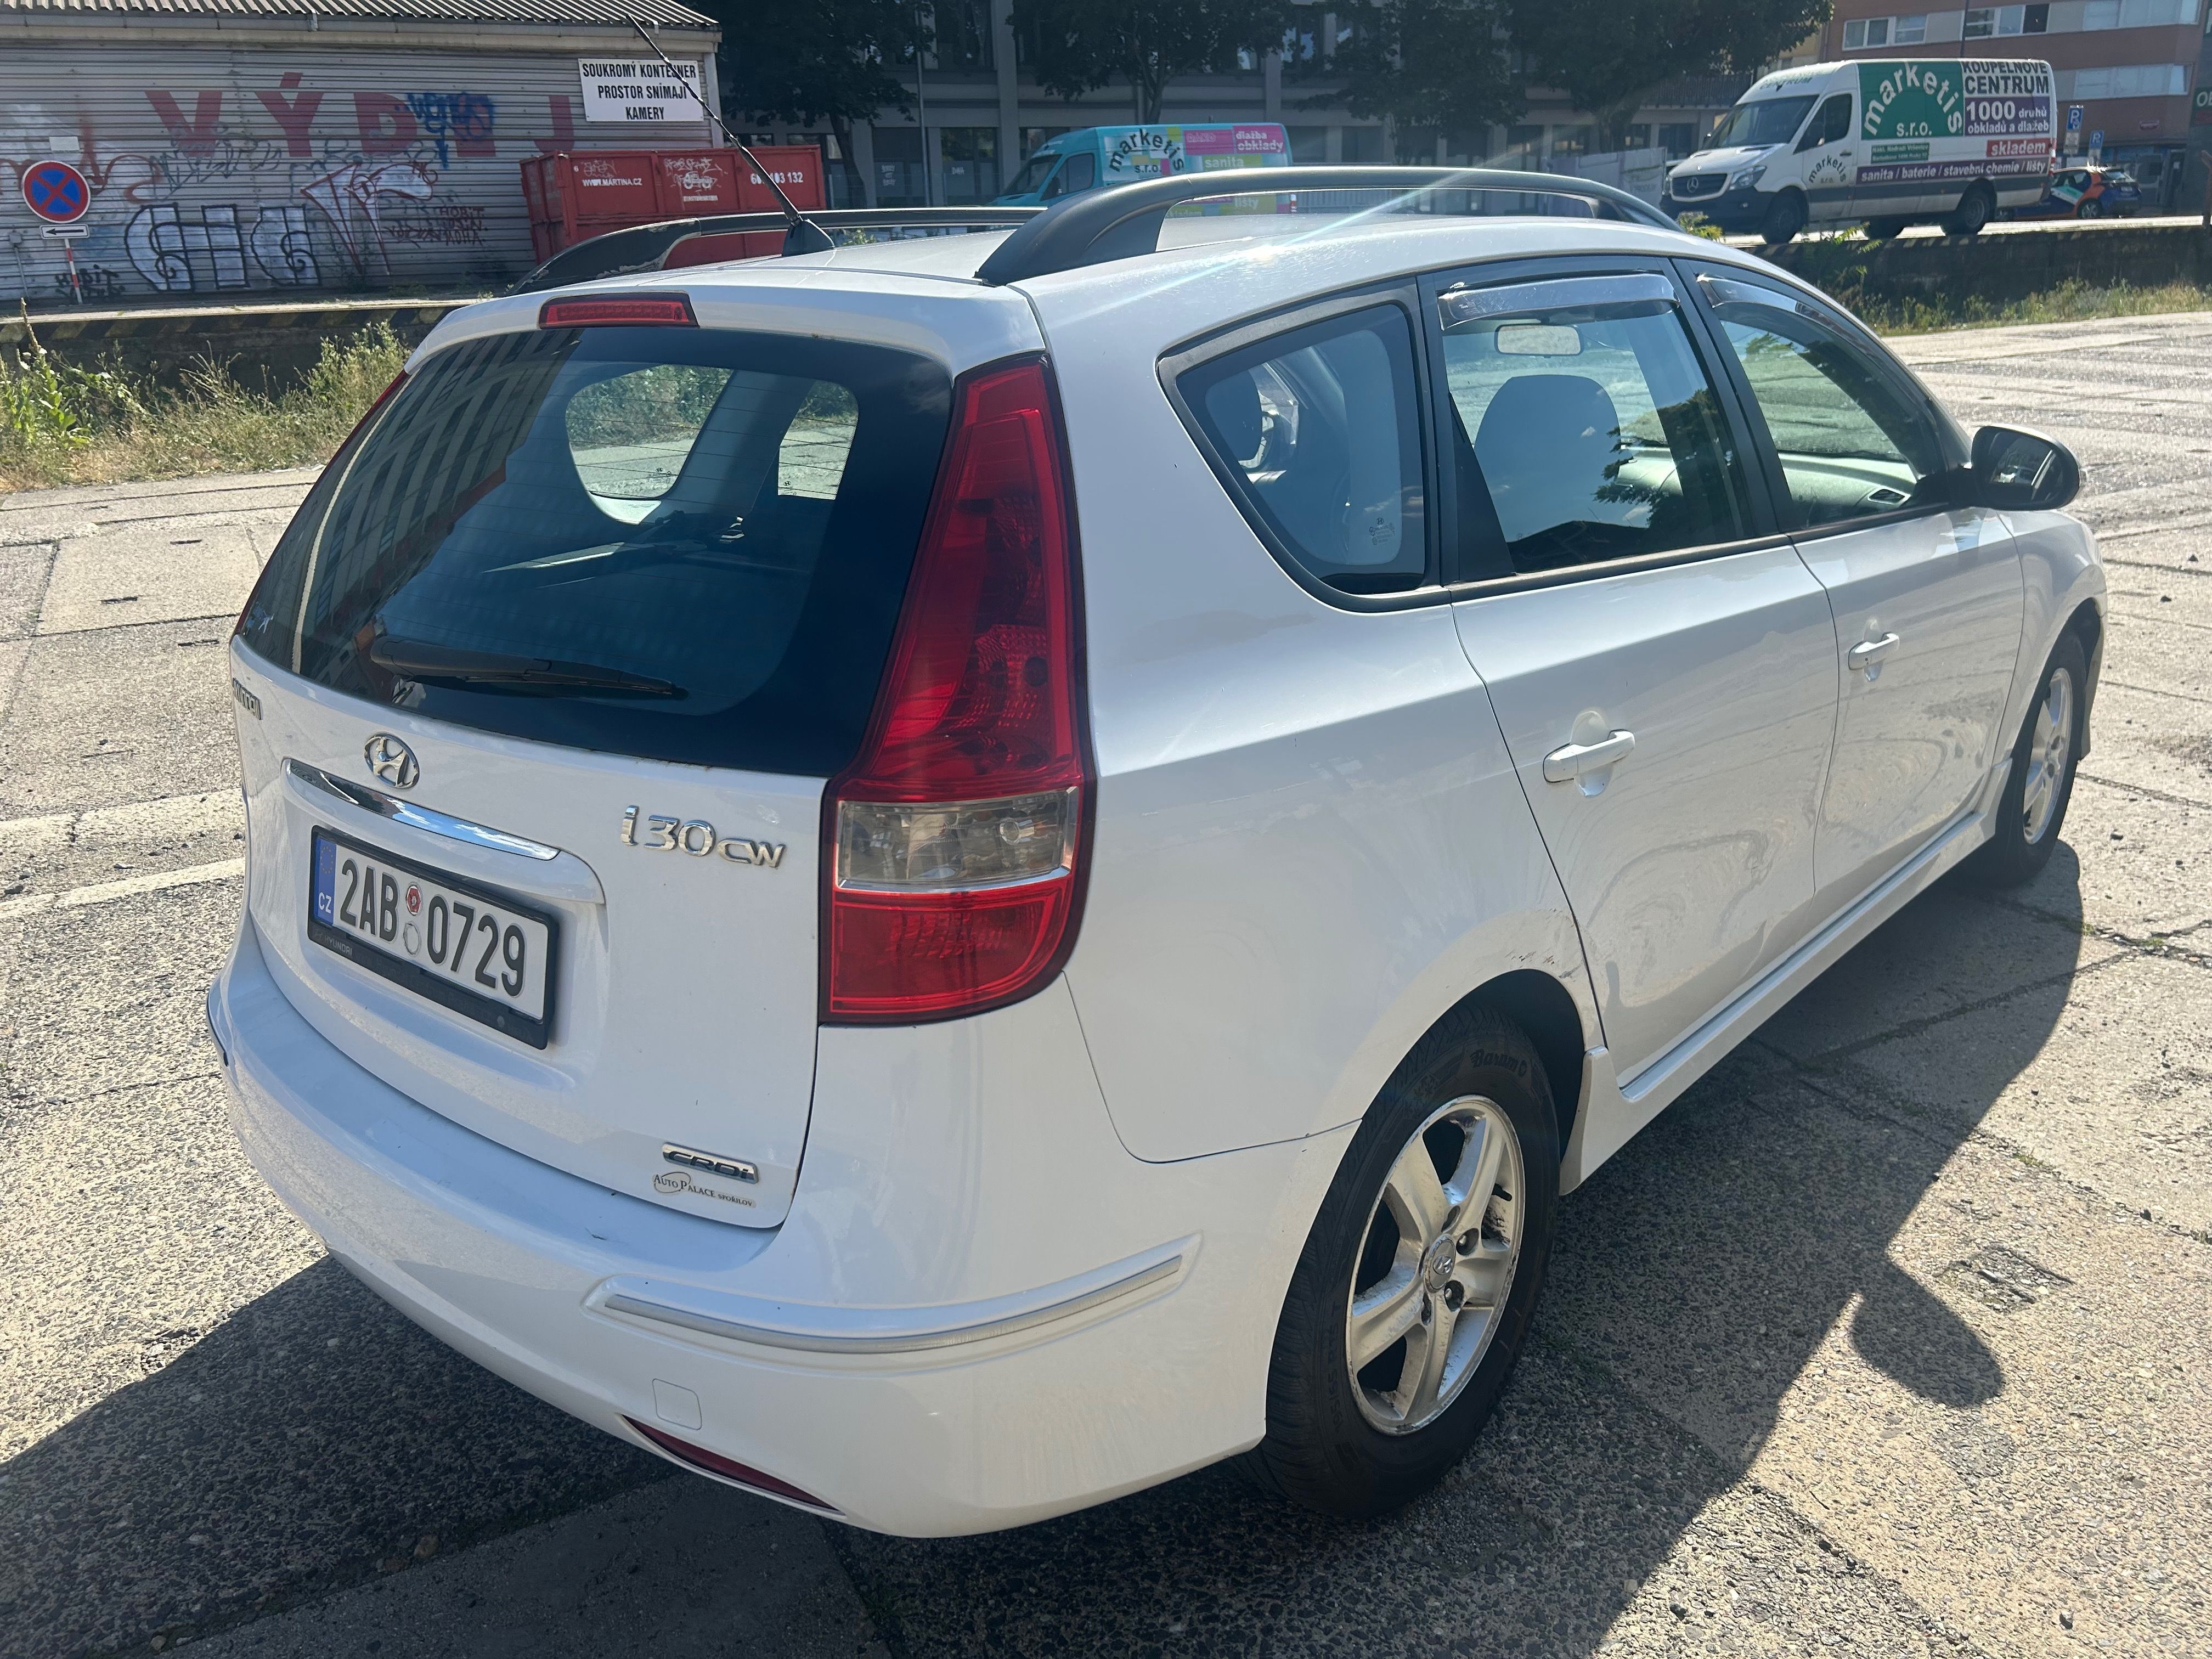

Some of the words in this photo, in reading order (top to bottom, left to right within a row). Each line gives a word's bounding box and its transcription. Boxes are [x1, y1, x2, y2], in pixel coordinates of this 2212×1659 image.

[583, 60, 636, 77] SOUKROMÝ
[598, 85, 644, 99] PROSTOR
[1965, 75, 2049, 94] CENTRUM
[1864, 61, 1962, 136] marketis
[625, 106, 664, 120] KAMERY
[1966, 101, 2016, 121] 1000
[2018, 106, 2047, 119] druhů
[1896, 122, 1932, 137] s.r.o.
[1967, 120, 2007, 134] obkladů
[2008, 124, 2016, 133] a
[2017, 119, 2050, 133] dlažeb
[1109, 128, 1185, 172] marketis
[1237, 140, 1284, 153] obklady
[1991, 141, 2046, 156] skladem
[1204, 156, 1244, 168] sanita
[787, 171, 804, 183] 132
[1861, 170, 1893, 182] sanita
[1901, 167, 1936, 179] baterie
[1986, 162, 2019, 174] chemie
[2026, 161, 2046, 174] lišty
[318, 891, 332, 914] CZ
[340, 858, 399, 943] 2AB
[427, 895, 526, 997] 0729
[324, 934, 353, 956] HYUNDAI
[669, 1150, 749, 1180] CRDi
